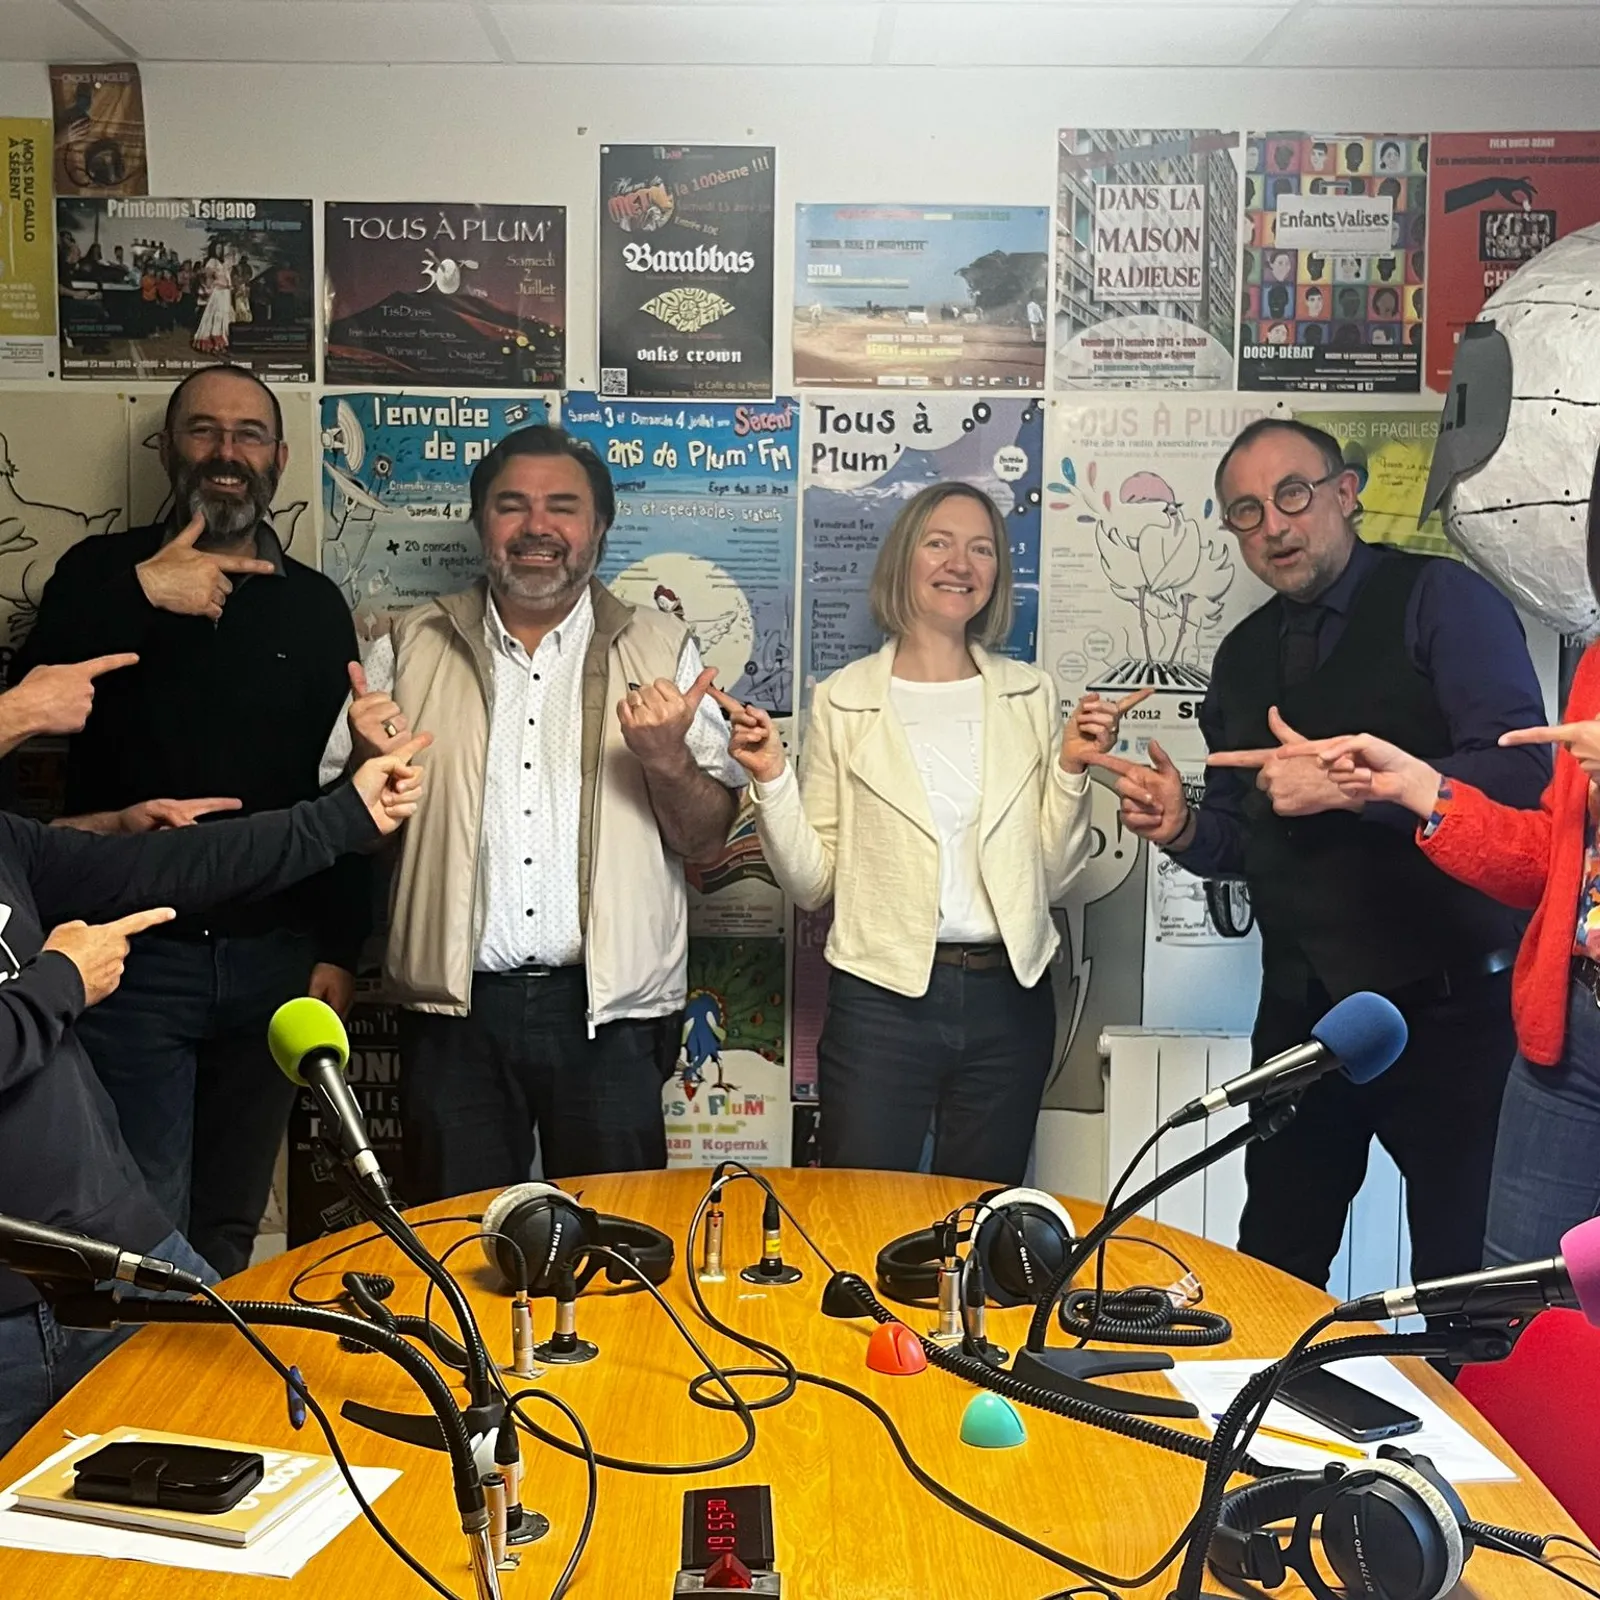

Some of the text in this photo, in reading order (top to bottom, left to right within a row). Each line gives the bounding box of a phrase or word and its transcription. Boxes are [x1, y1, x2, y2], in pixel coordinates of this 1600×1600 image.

[692, 164, 750, 191] 100ème
[752, 155, 770, 173] !!!
[22, 138, 34, 242] MOIS DU GALLO
[1100, 188, 1201, 210] DANS LA
[108, 199, 256, 220] Printemps Tsigane
[1280, 209, 1390, 228] Enfants Valises
[342, 211, 552, 243] TOUS À PLUM'
[1098, 227, 1200, 253] MAISON
[506, 251, 556, 267] Samedi
[622, 242, 755, 274] Barabbas
[524, 268, 532, 282] 2
[1098, 266, 1201, 288] RADIEUSE
[516, 279, 556, 296] Juillet
[686, 350, 742, 362] crown
[604, 406, 614, 428] 3
[676, 410, 685, 429] 4
[816, 402, 933, 434] Tous à
[1152, 402, 1171, 437] À
[1372, 422, 1439, 438] FRAGILES
[425, 430, 456, 461] de
[607, 438, 644, 468] ans
[653, 441, 678, 469] de
[811, 442, 900, 474] Plum'
[442, 502, 451, 520] 4
[642, 501, 656, 515] et
[660, 502, 735, 521] spectacles
[813, 518, 856, 528] Vendredi
[404, 540, 420, 552] 20
[422, 542, 468, 552] concerts
[850, 562, 858, 574] 2
[1132, 710, 1161, 720] 2012
[702, 1139, 768, 1153] Kopernik
[1354, 1538, 1368, 1560] PRO
